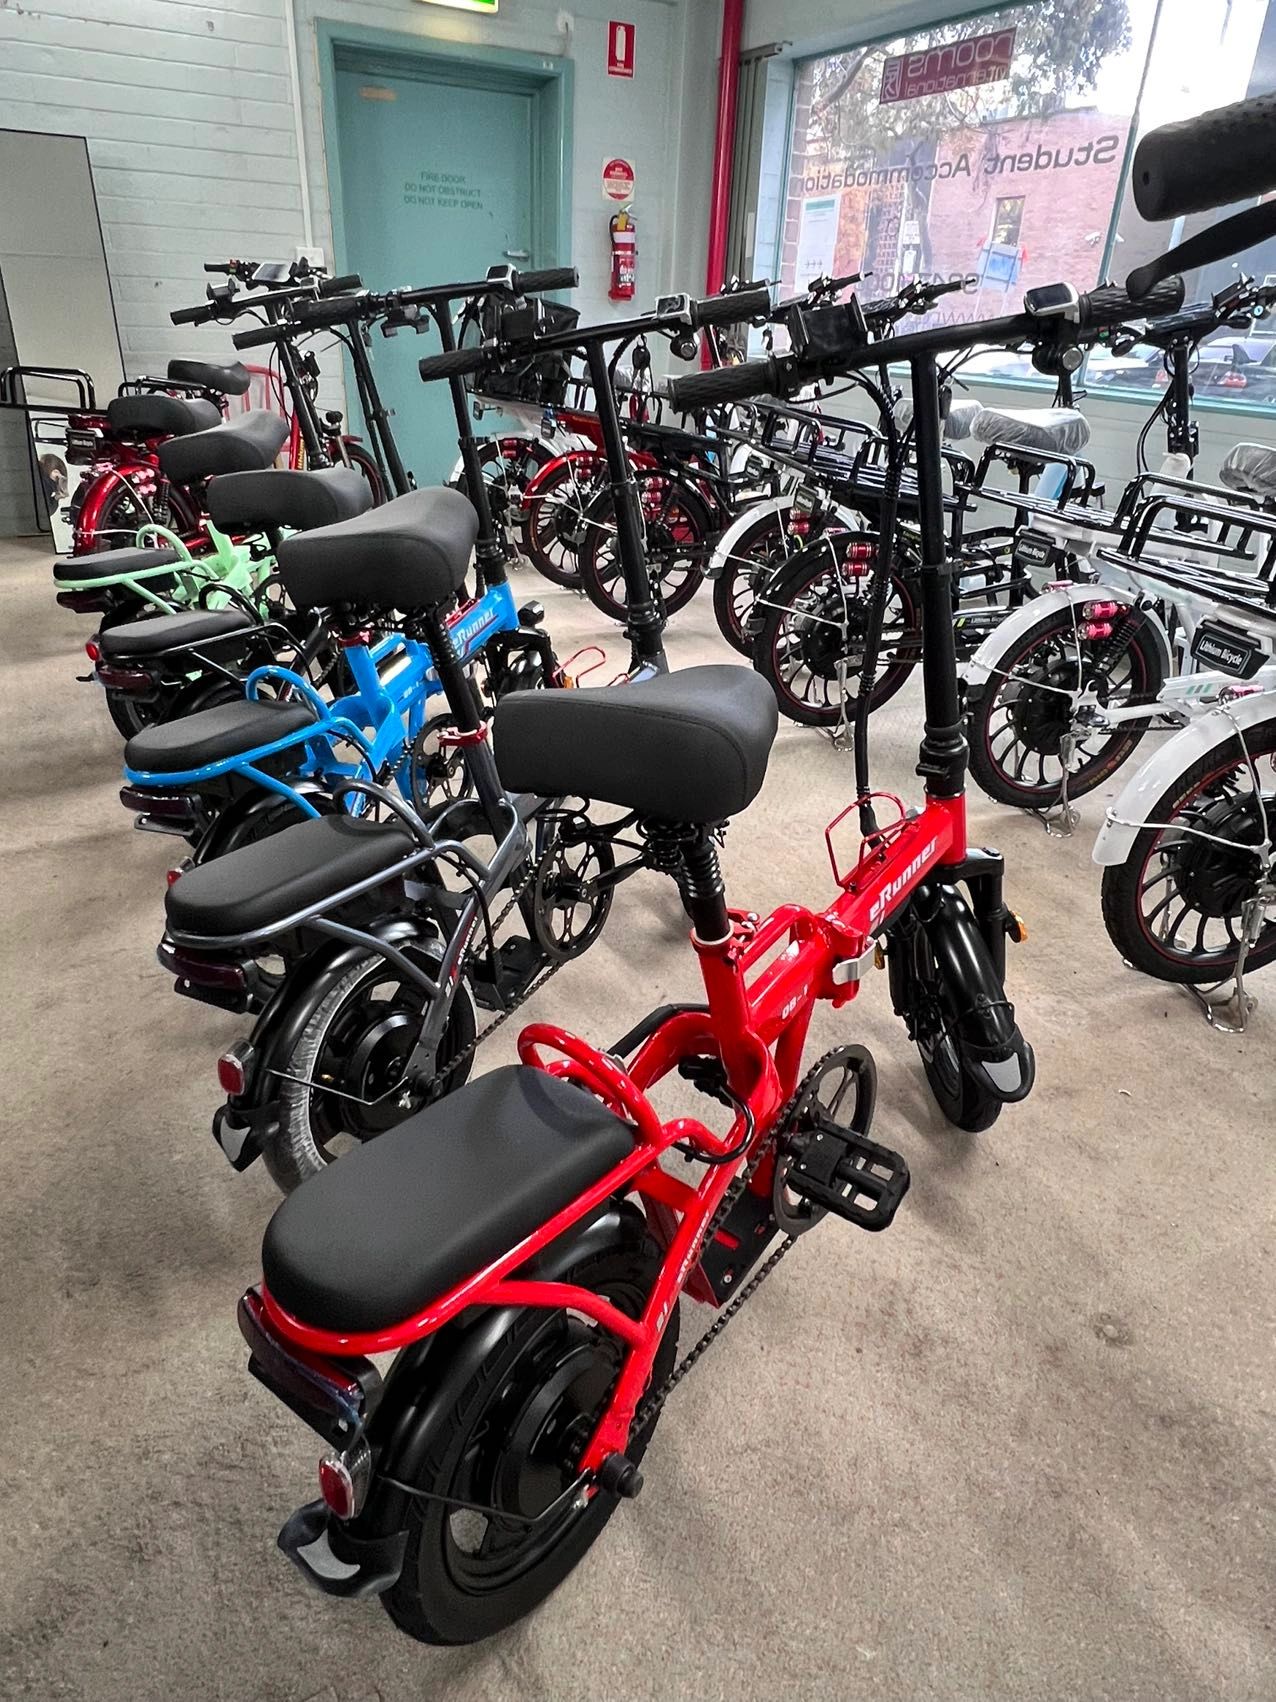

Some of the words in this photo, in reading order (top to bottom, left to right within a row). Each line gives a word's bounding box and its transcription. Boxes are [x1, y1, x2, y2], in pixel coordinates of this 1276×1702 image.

[405, 182, 417, 192] DO
[1199, 640, 1222, 657] Lithium
[1220, 648, 1243, 666] Bicycle
[869, 835, 938, 923] eRunner
